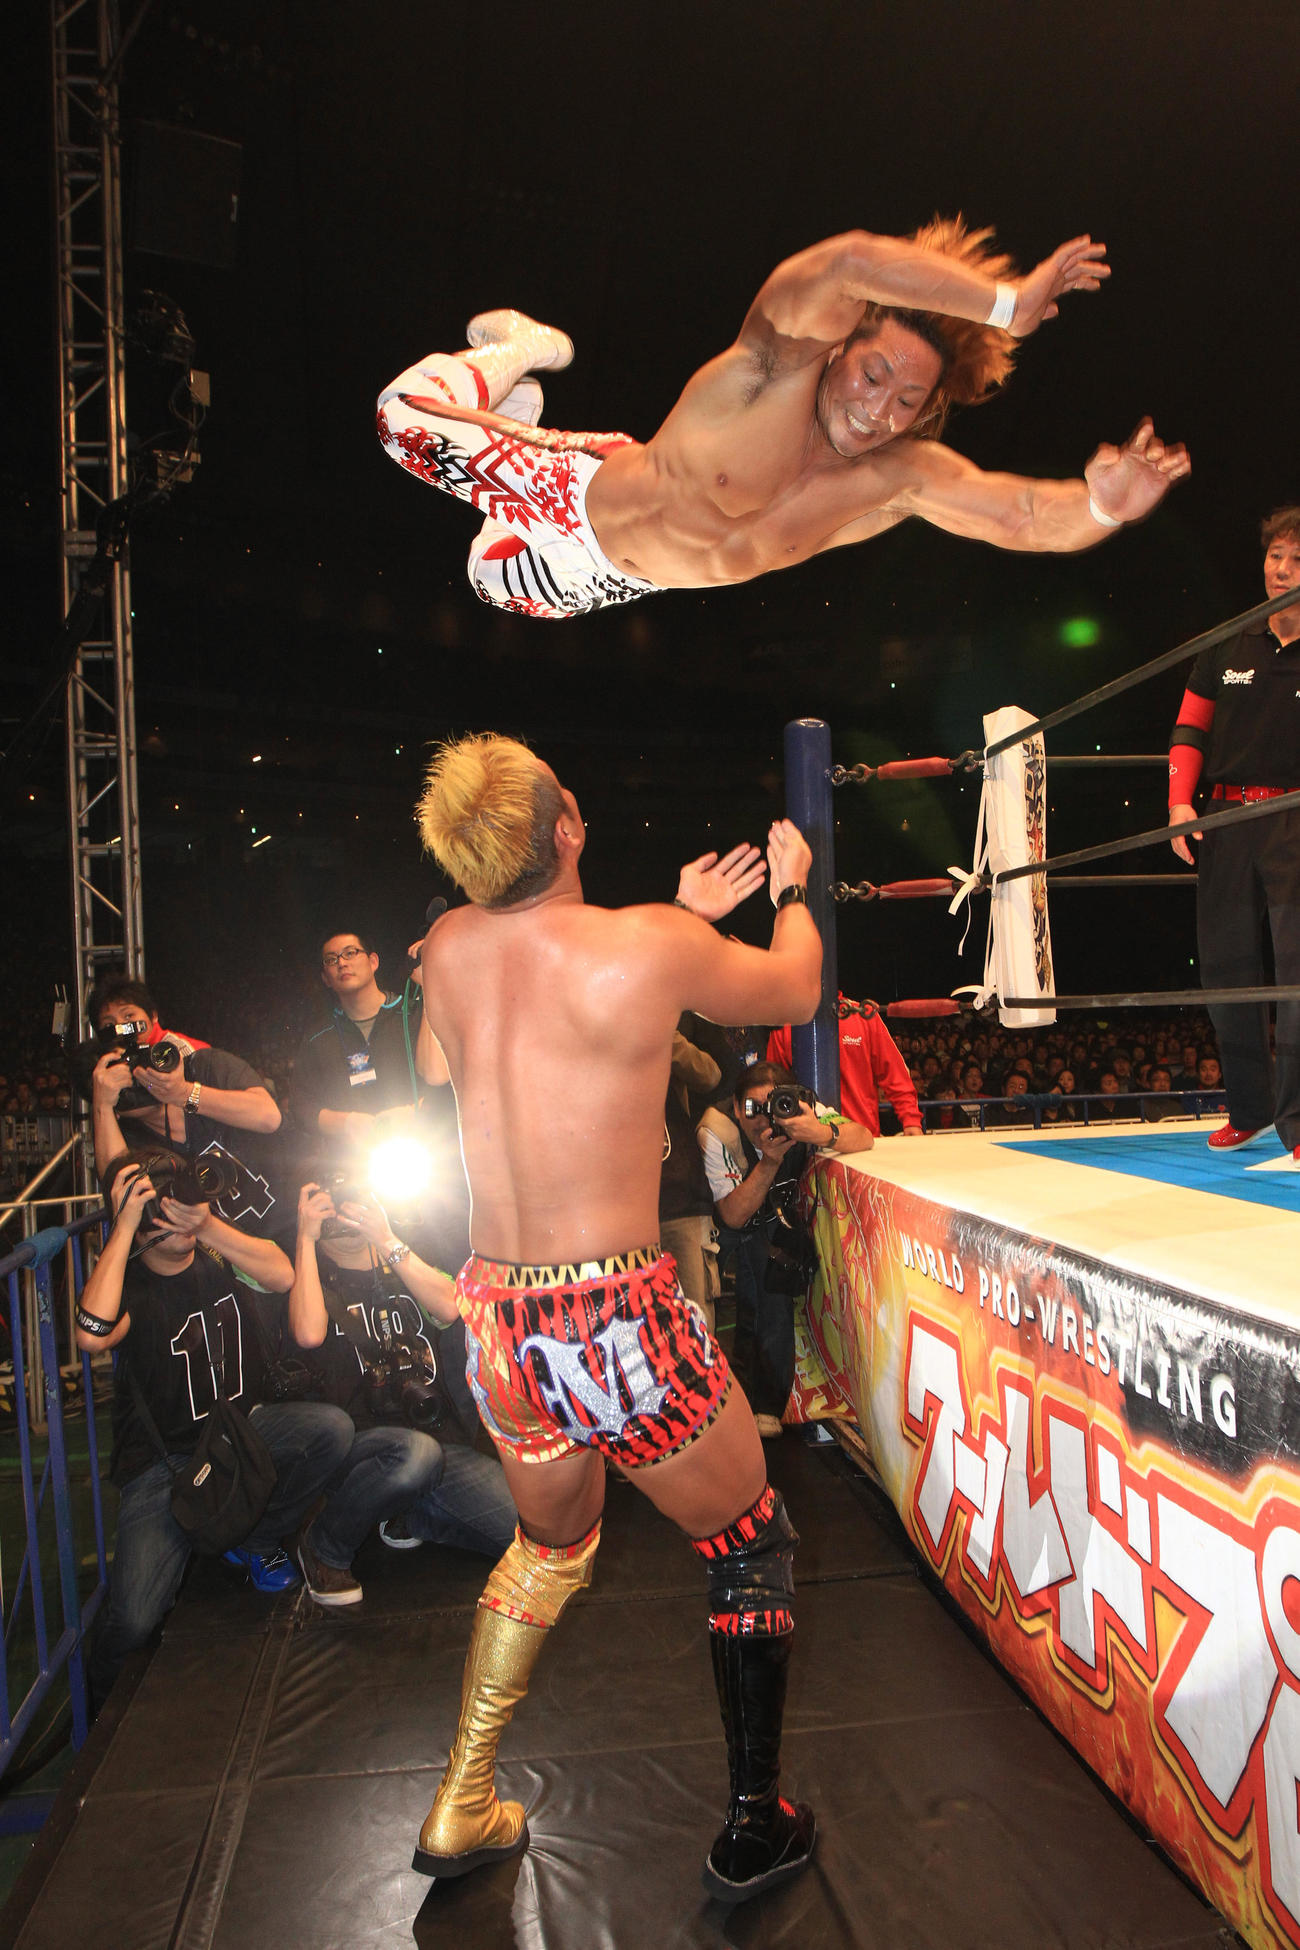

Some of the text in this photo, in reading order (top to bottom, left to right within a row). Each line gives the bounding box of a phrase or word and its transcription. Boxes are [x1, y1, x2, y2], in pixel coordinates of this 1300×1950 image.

[381, 1320, 392, 1341] NPS
[899, 1231, 1237, 1438] WORLD PRO-WRESTLING
